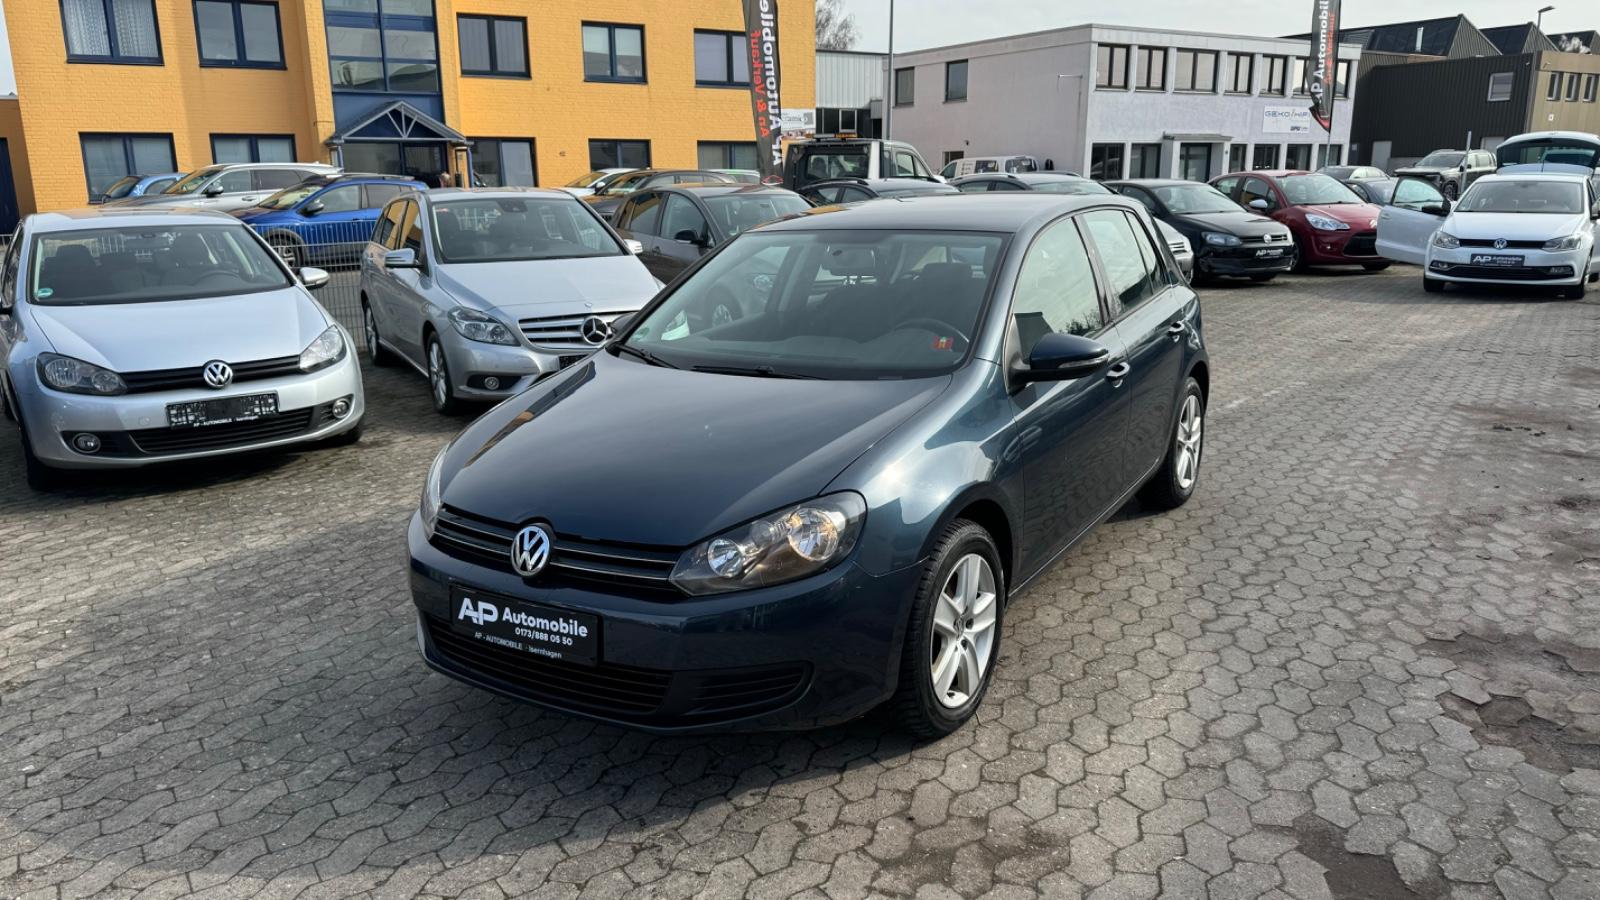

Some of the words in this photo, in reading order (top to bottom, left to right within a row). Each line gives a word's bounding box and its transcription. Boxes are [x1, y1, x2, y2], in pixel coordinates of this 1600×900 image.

[1313, 0, 1329, 79] Automobil
[1473, 255, 1492, 263] AP
[458, 597, 499, 626] AP
[502, 607, 588, 637] Automobile
[486, 635, 523, 650] AUTOMOBILE
[514, 627, 549, 642] 0173/888
[549, 635, 561, 645] 05
[562, 637, 573, 646] 50
